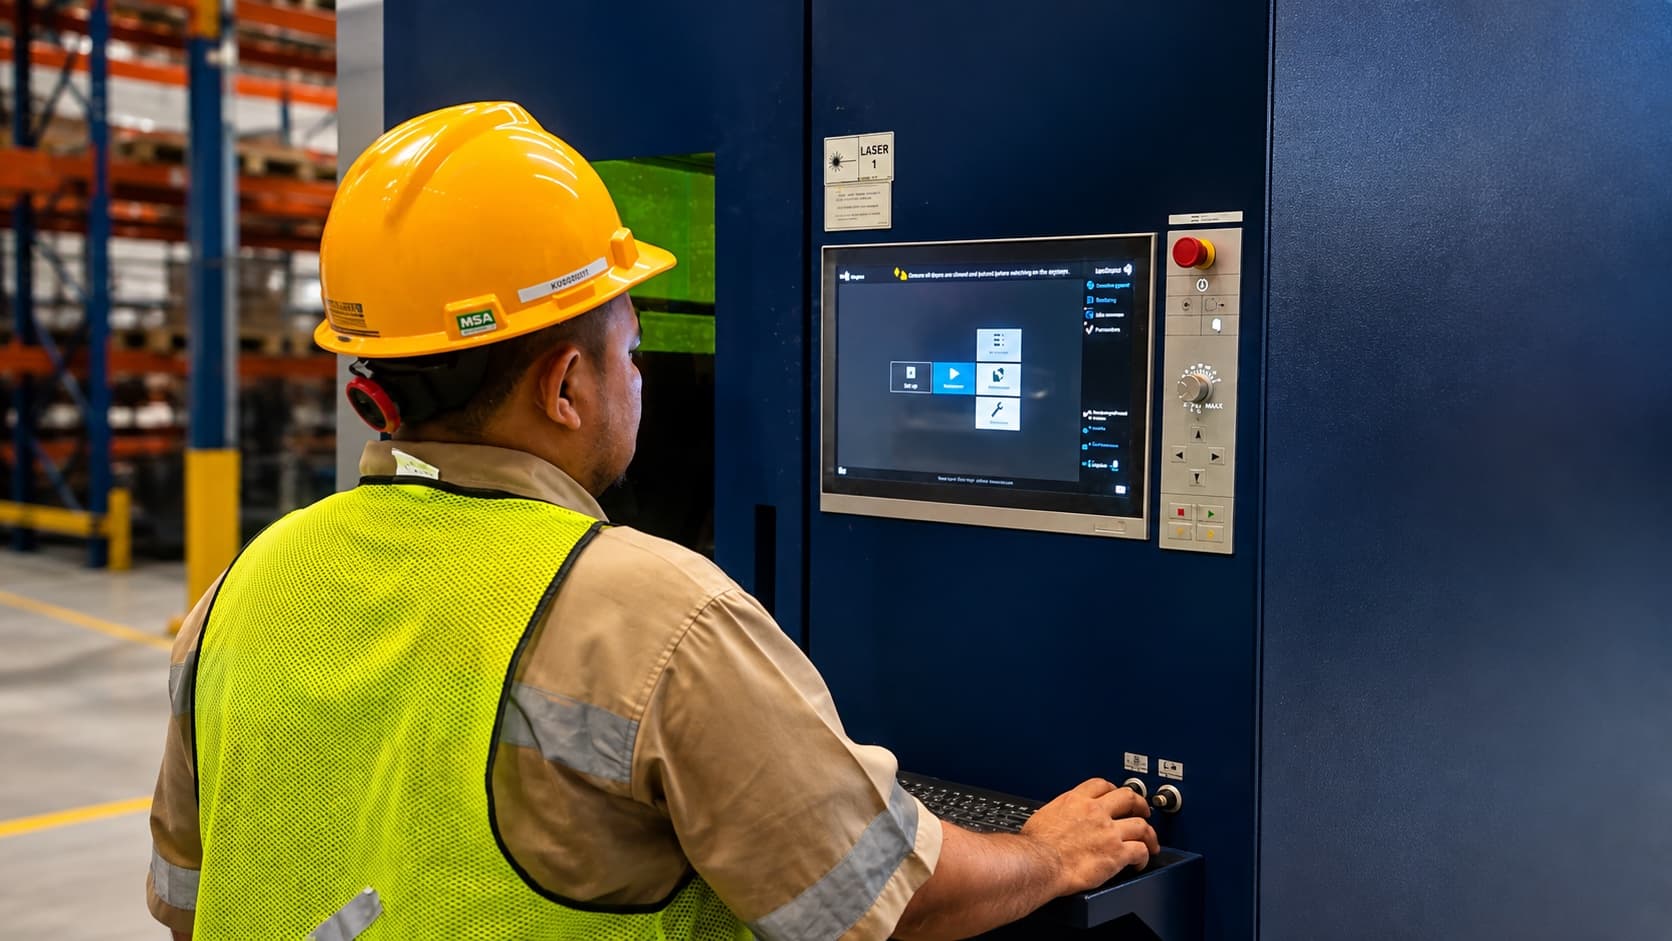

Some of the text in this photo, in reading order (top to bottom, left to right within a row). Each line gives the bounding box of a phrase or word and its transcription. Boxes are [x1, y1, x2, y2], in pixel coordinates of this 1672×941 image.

[860, 144, 889, 156] LASER
[872, 159, 876, 169] 1
[460, 312, 494, 328] MSA
